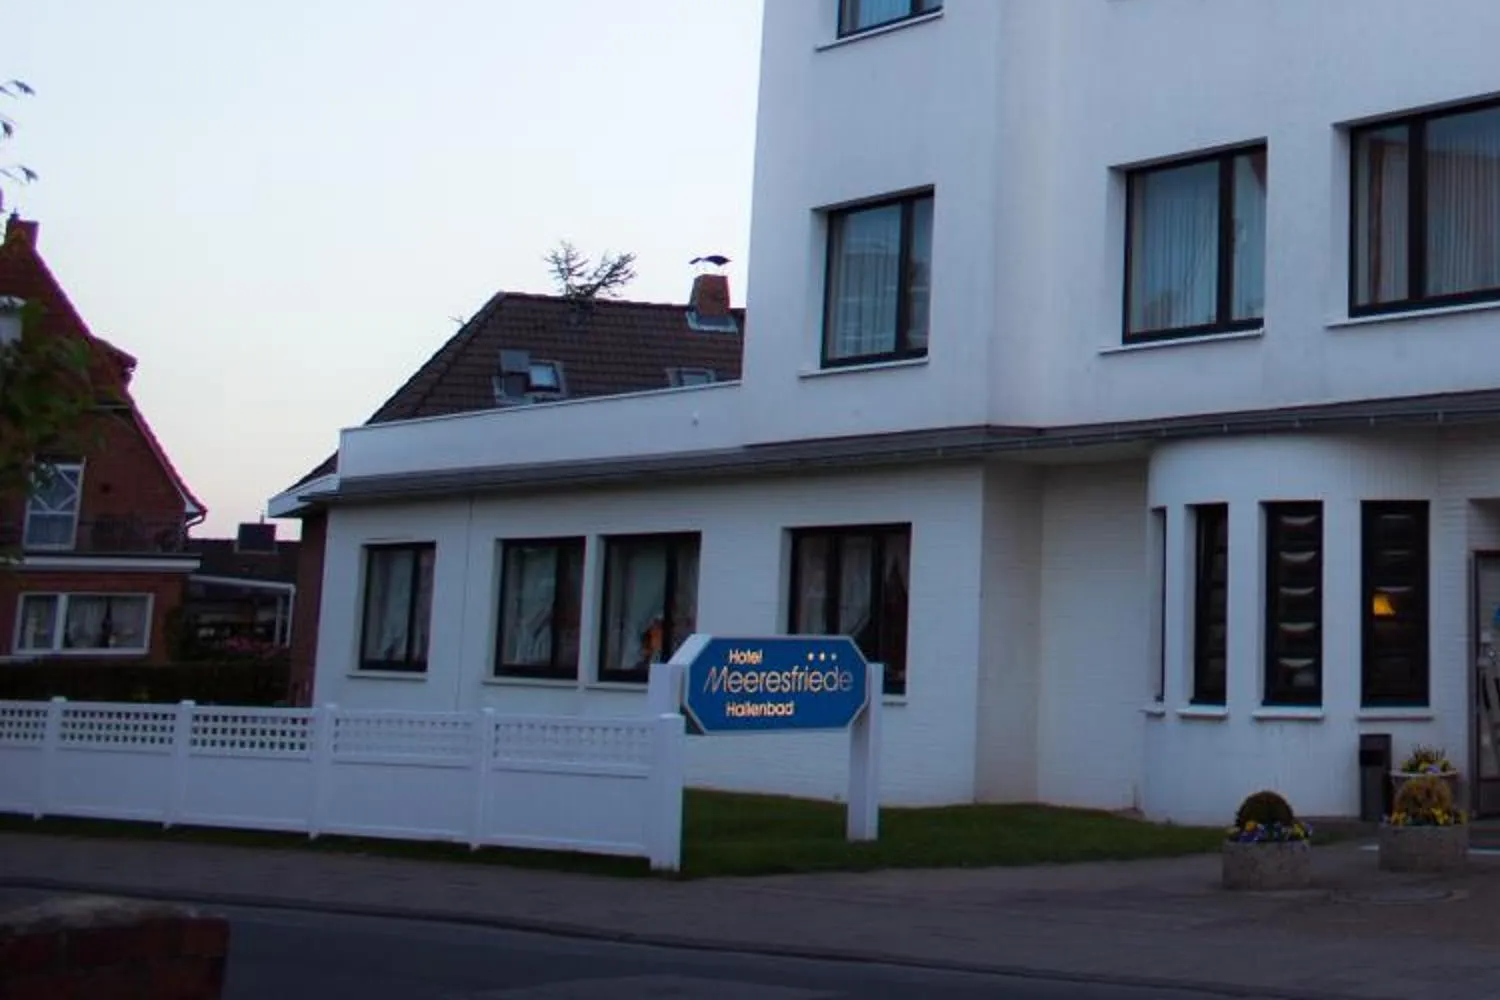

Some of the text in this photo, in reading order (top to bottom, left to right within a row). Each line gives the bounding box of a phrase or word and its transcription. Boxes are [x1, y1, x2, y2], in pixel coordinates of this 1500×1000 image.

[729, 649, 763, 664] Hotel
[703, 665, 853, 693] Meeresfriede
[726, 701, 795, 717] Hallenbad
